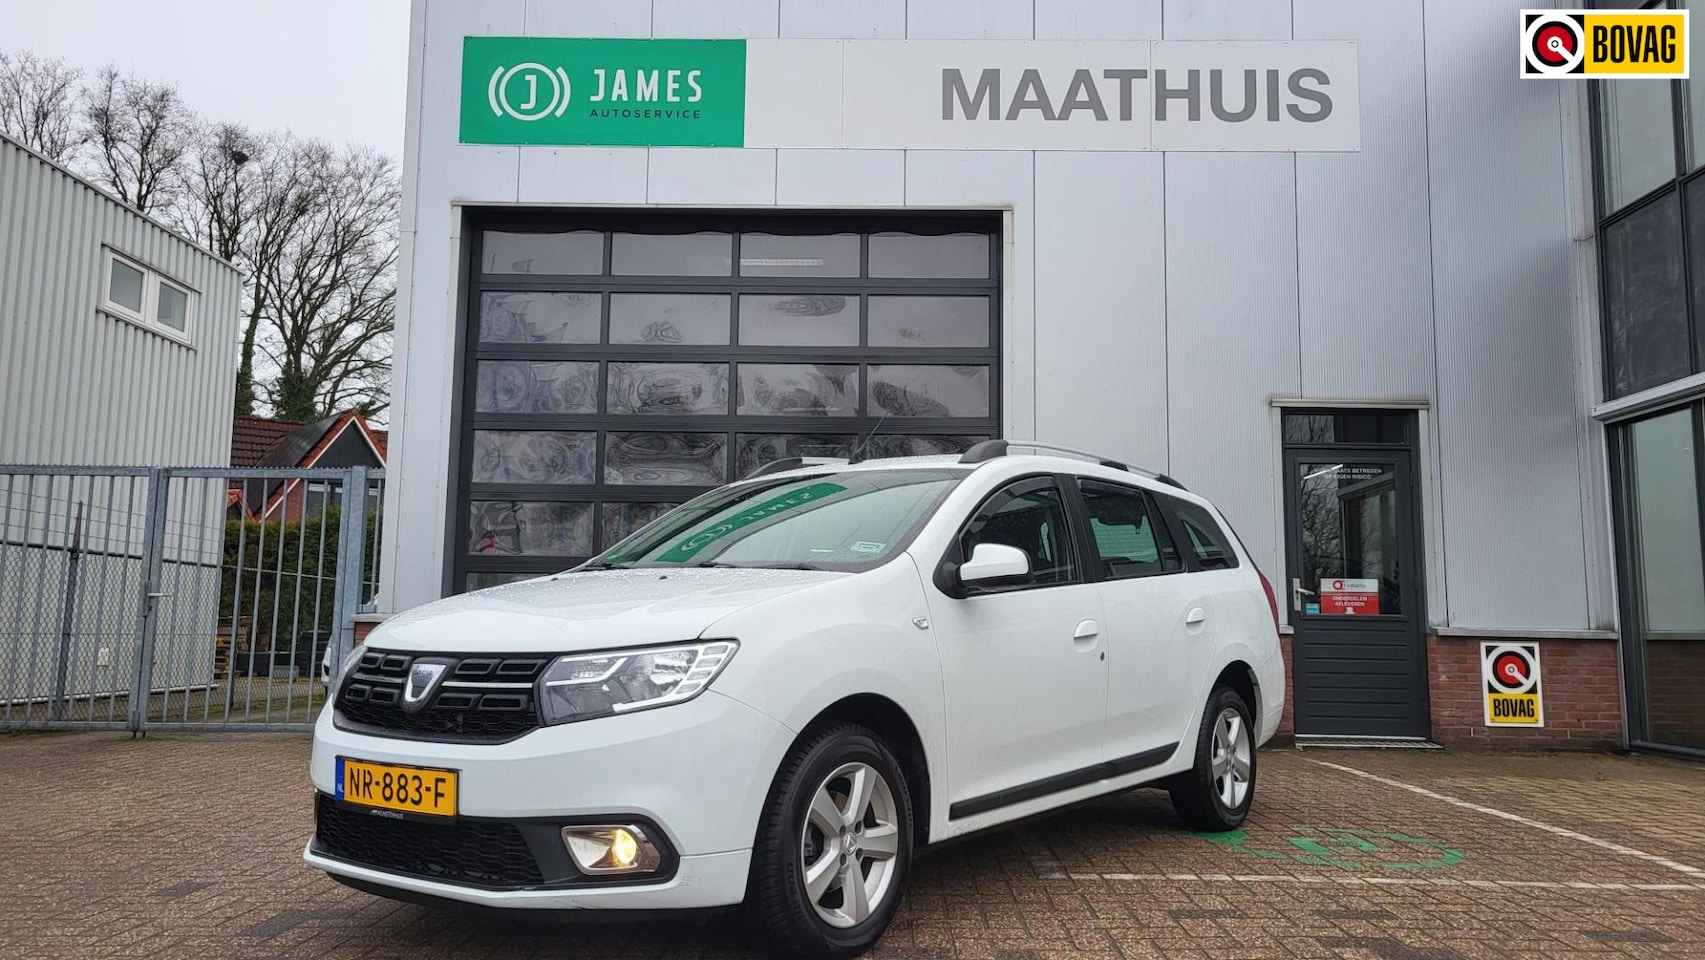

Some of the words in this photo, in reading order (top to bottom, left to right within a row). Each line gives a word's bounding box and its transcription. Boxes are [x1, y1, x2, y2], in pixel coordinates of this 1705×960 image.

[590, 69, 703, 102] JAMES
[942, 68, 1333, 123] MAATHUIS
[590, 109, 701, 119] AUTOSERVICE
[1493, 698, 1535, 718] BOVAG
[350, 767, 447, 807] NR-883-F
